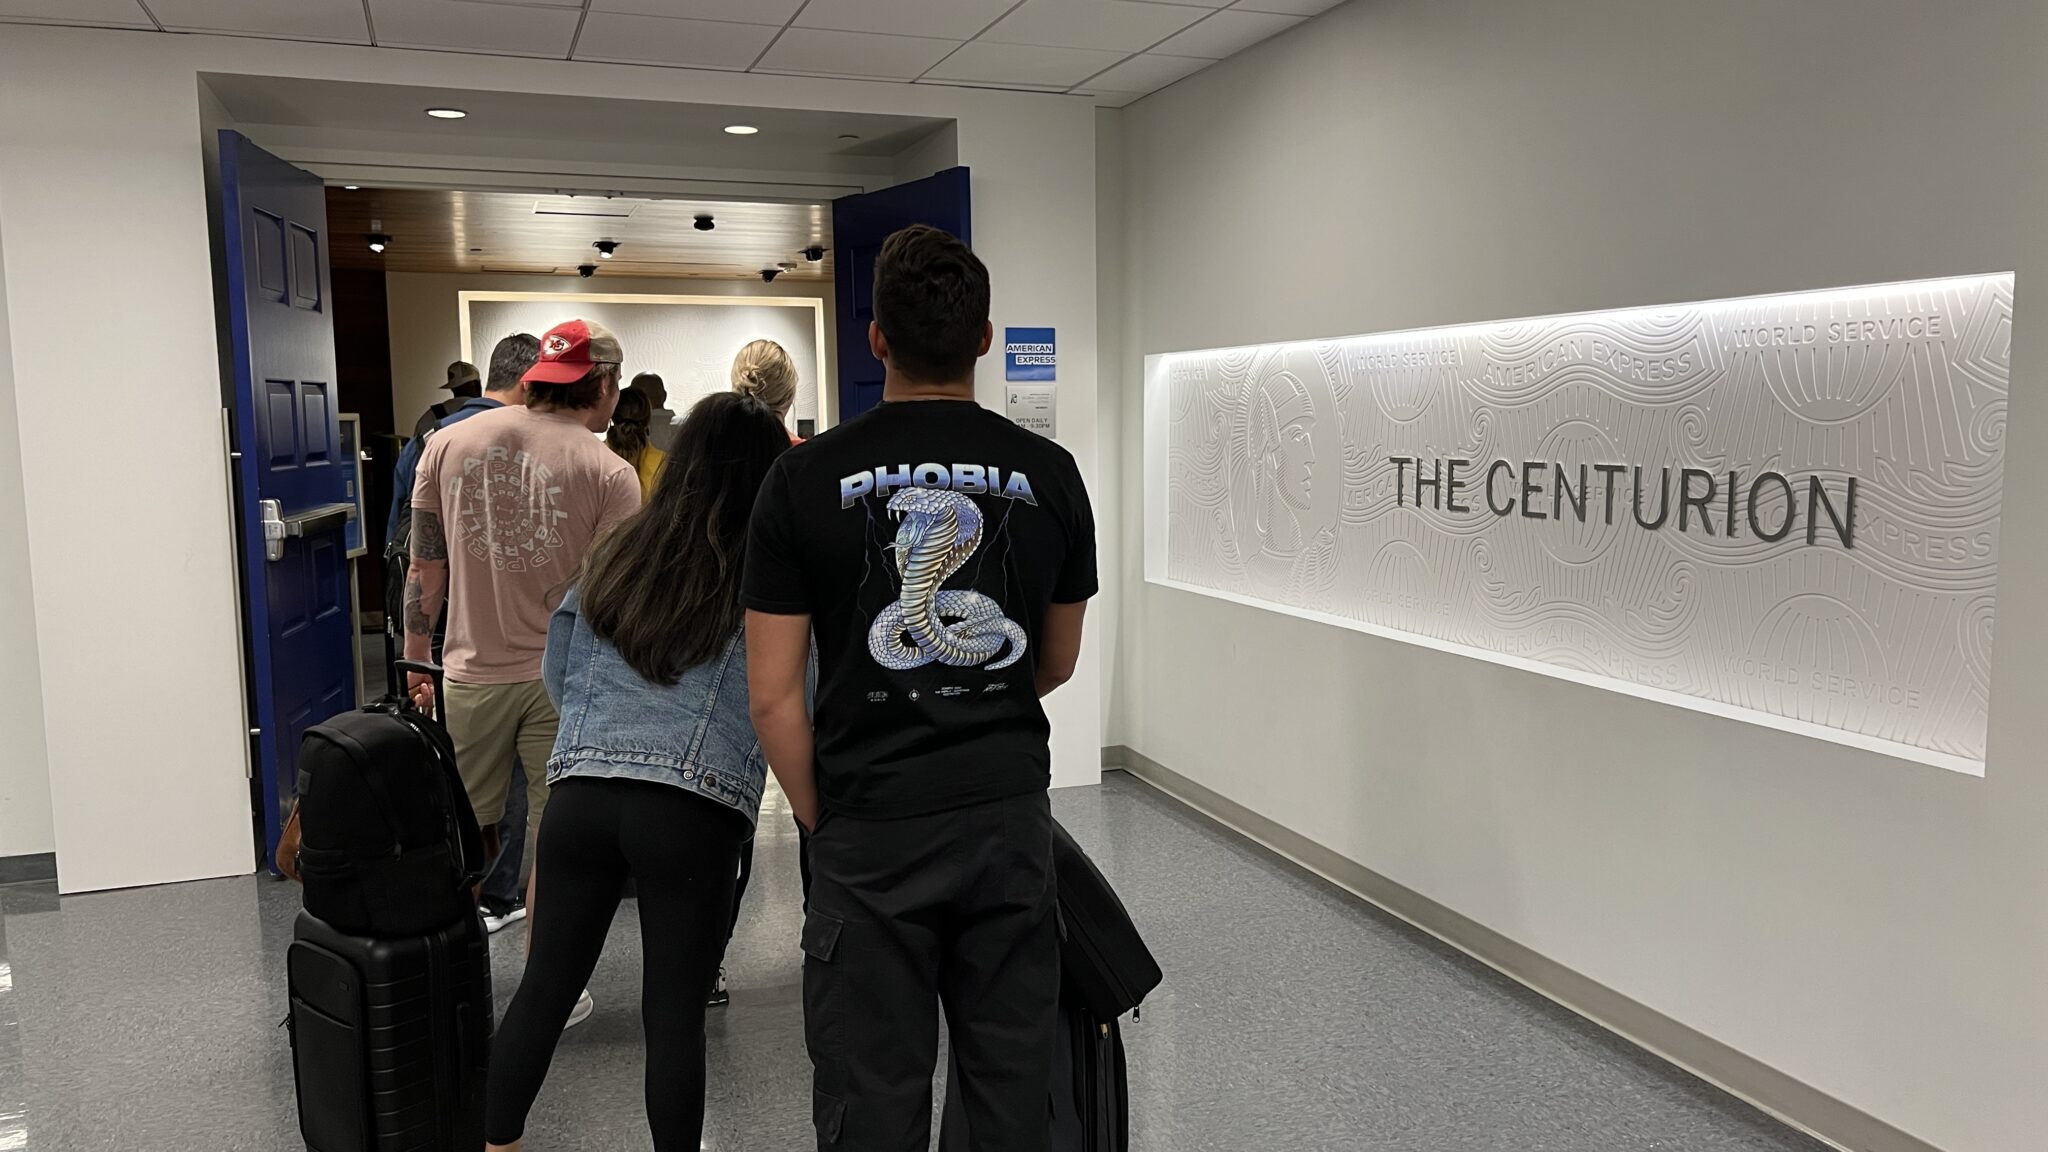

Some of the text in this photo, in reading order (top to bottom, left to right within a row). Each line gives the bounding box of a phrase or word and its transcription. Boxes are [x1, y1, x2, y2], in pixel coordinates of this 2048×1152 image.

[1006, 344, 1052, 352] AMERICAN
[1734, 315, 1942, 348] WORLD SERVICE
[1017, 356, 1056, 364] EXPRESS
[1355, 350, 1456, 371] WORLD SERVICE
[1482, 338, 1691, 387] AMERICAN EXPRESS
[840, 462, 1039, 509] PHOBIA
[1389, 456, 1470, 512] THE
[1485, 458, 1858, 550] CENTURION
[1853, 507, 1993, 563] XPRESS
[1398, 594, 1451, 617] SERVICE
[1476, 623, 1679, 686] AMERICAN EXPRESS
[1721, 652, 1922, 711] WORLD SERVICE
